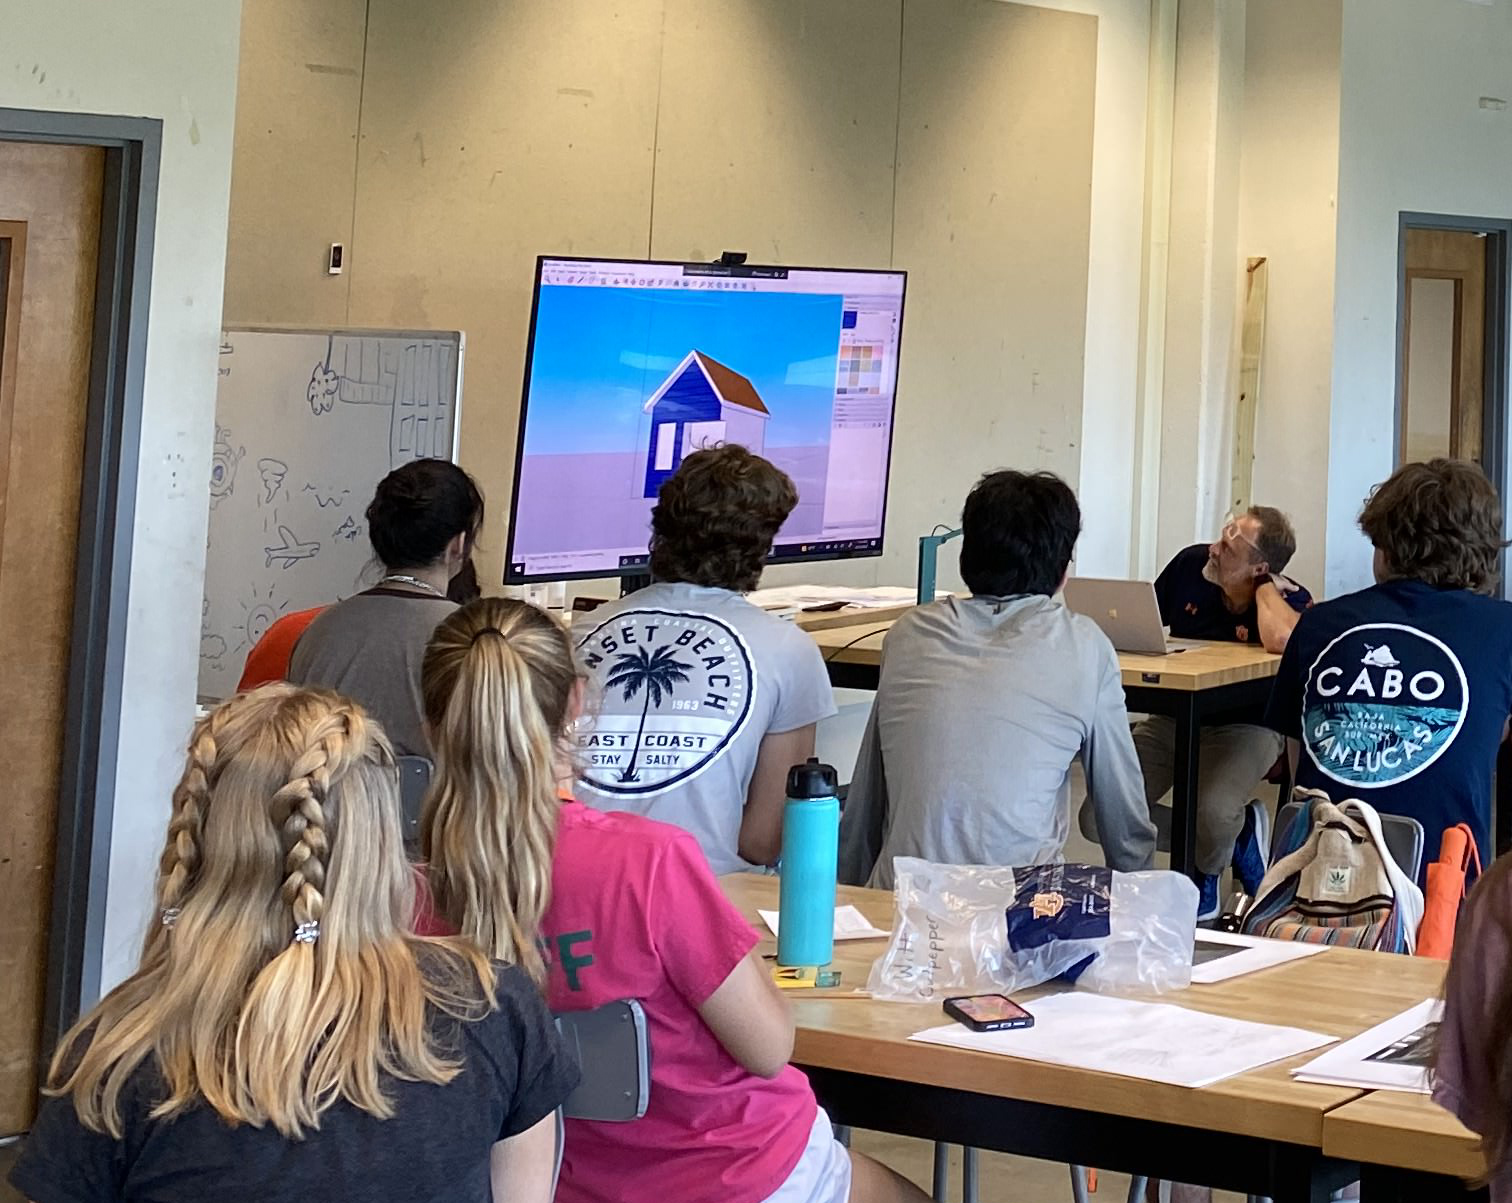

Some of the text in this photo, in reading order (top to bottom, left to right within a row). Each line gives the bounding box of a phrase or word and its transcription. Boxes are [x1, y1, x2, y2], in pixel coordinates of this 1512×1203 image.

[585, 625, 731, 710] NSET BEACH
[1316, 666, 1445, 701] CABO
[672, 700, 699, 711] 1963
[578, 735, 707, 748] EAST COAST
[1315, 719, 1433, 773] SAN LUCAS
[591, 755, 680, 765] STAY SALTY
